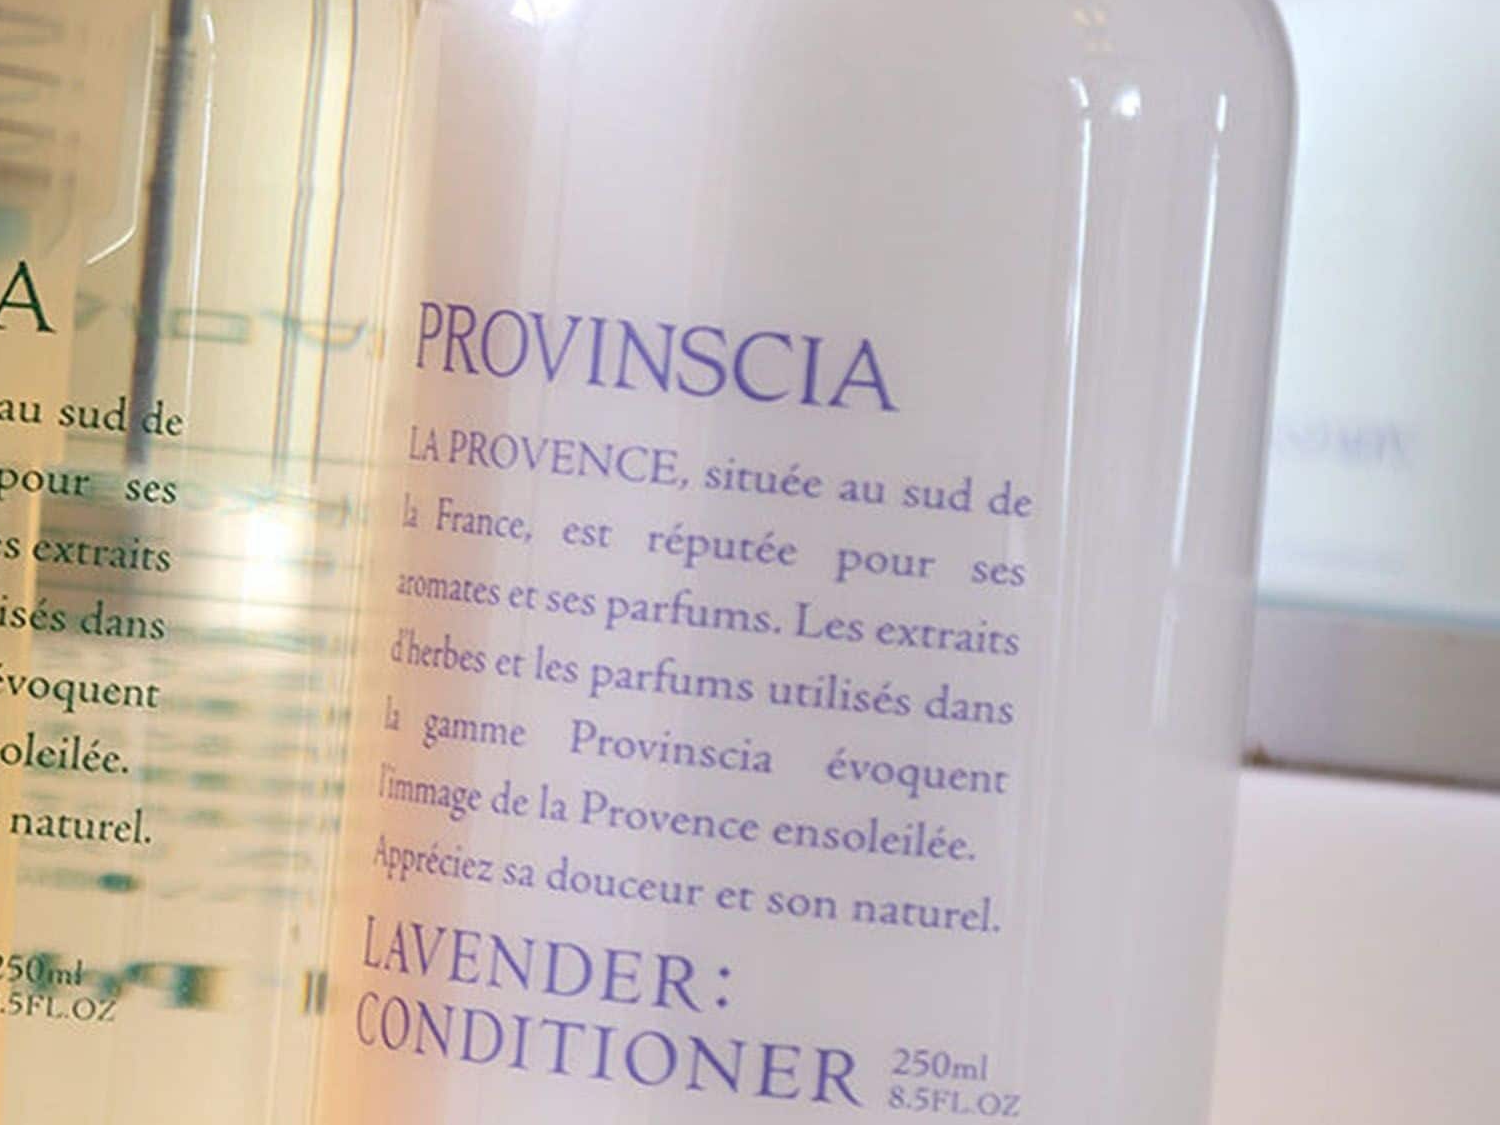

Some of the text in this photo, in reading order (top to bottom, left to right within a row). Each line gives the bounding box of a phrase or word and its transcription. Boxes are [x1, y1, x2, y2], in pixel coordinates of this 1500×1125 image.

[416, 302, 899, 413] PROVINSCIA
[58, 396, 127, 432] sud
[141, 400, 183, 438] de
[125, 476, 177, 505] ses
[409, 426, 1033, 519] LA PROVENCE, située au sud de
[33, 537, 171, 573] extraits
[403, 493, 1026, 587] la France, est réputée pour ses
[79, 600, 165, 641] dans
[397, 573, 1020, 656] aromates et ses parfums. Les extraits
[496, 653, 524, 679] et
[535, 645, 578, 684] les
[590, 657, 754, 702] parfums
[769, 675, 911, 716] utilisés
[925, 685, 1014, 725] dans
[385, 696, 1009, 798] la gamme Provinscia évoquent
[9, 808, 152, 844] naturel.
[379, 762, 976, 862] l'immage de la Provence ensoleilée.
[374, 835, 1001, 933] Appréciez sa douceur et son naturel.
[363, 914, 731, 1013] LAVENDER:
[356, 991, 864, 1108] CONDITIONER
[892, 1048, 988, 1080] 250ml
